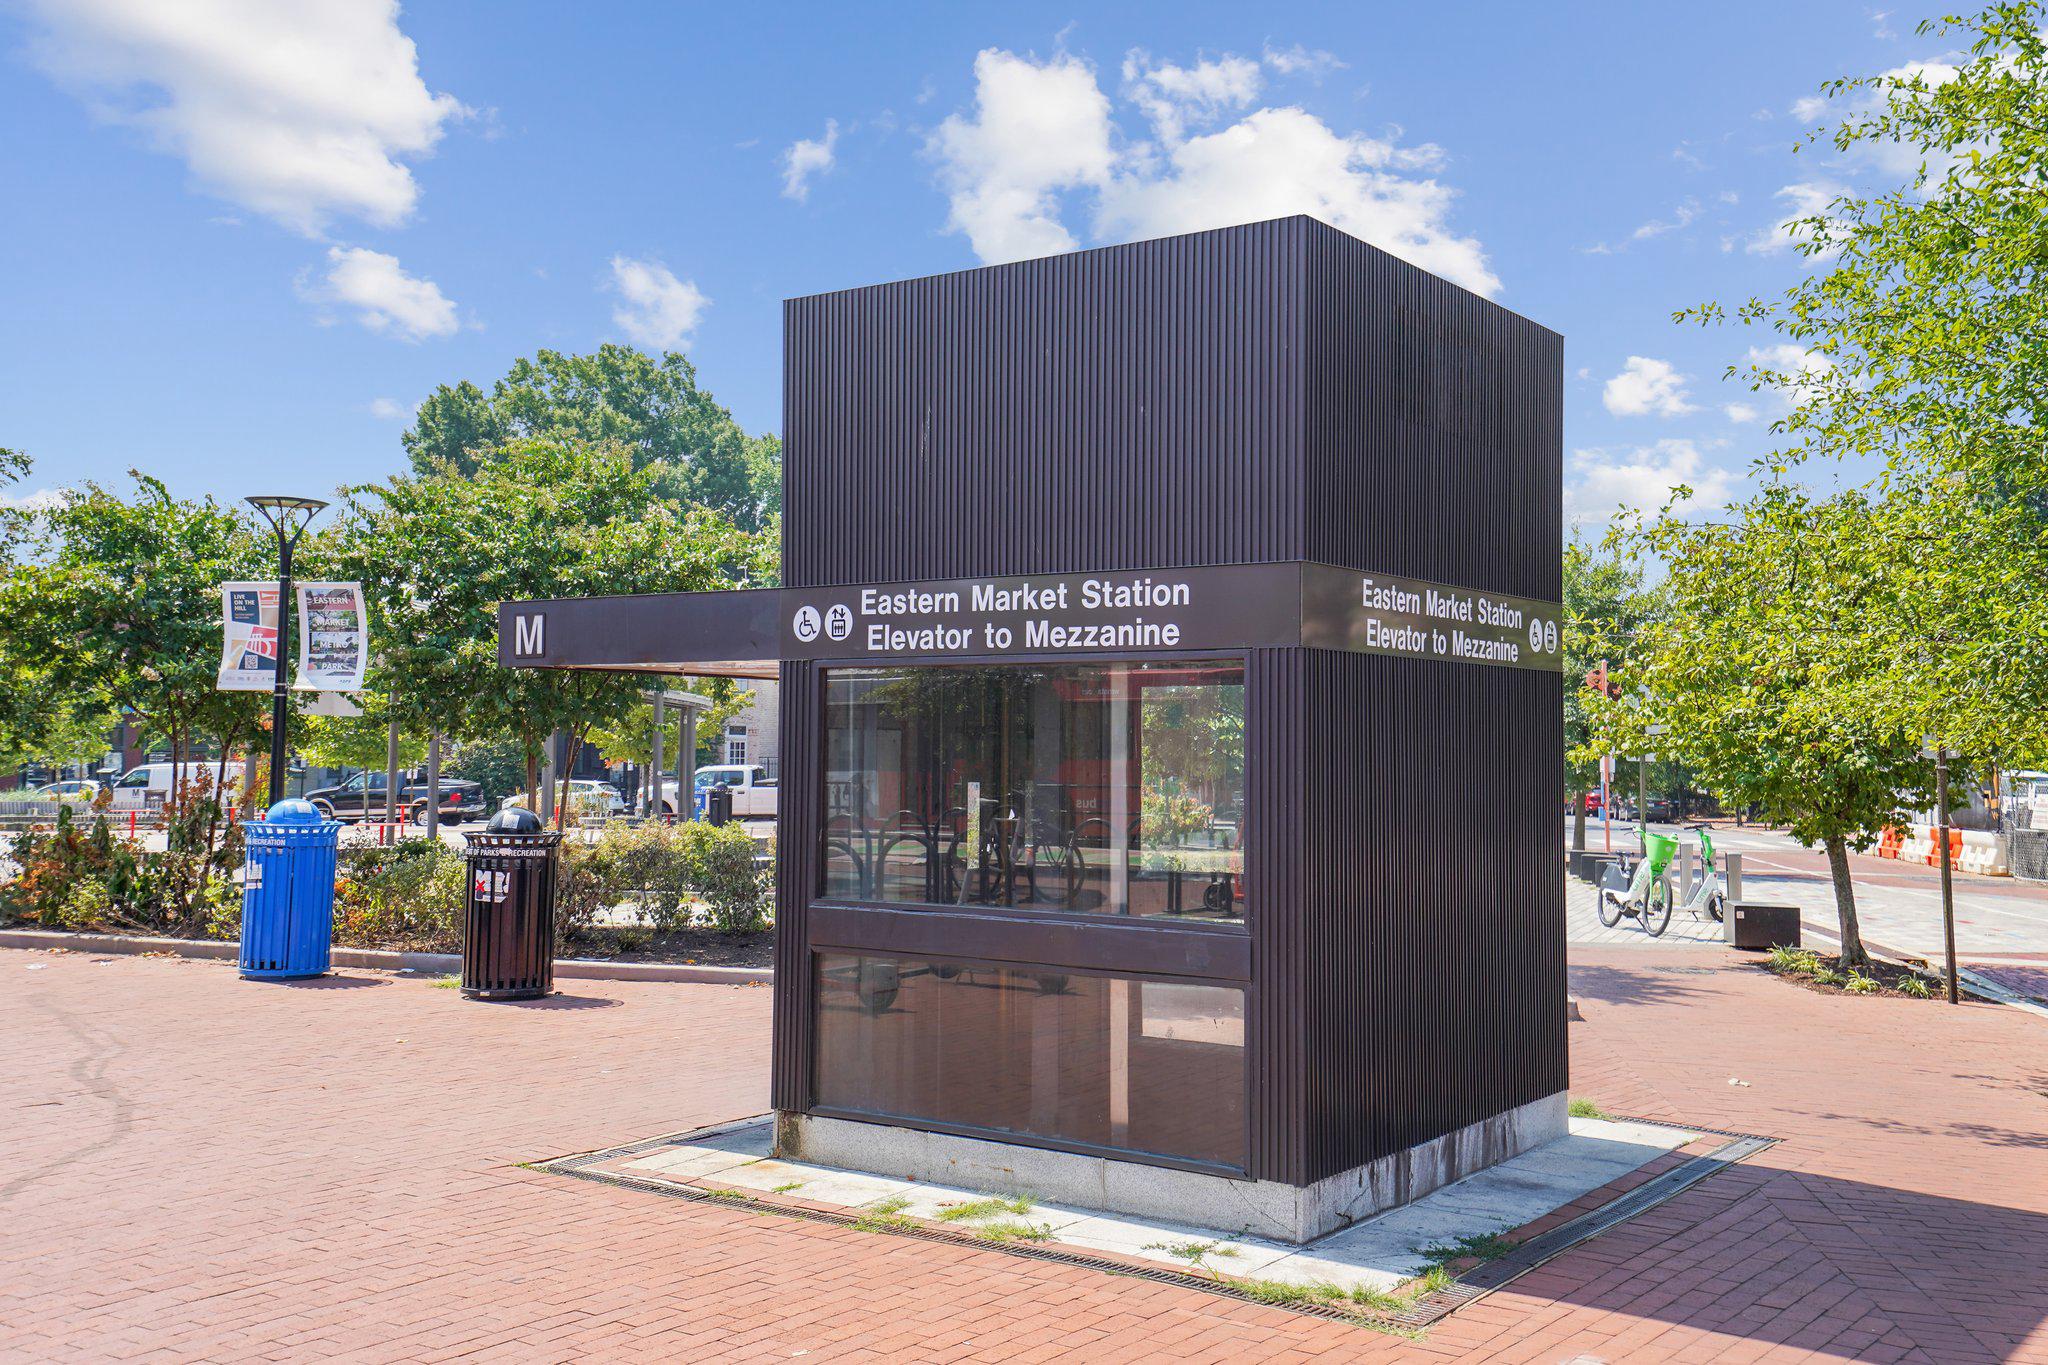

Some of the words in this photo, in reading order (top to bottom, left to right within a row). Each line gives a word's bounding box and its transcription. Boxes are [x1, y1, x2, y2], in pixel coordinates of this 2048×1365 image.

[313, 597, 348, 605] EASTERN
[861, 589, 960, 616] Eastern
[971, 582, 1068, 613] Market
[1081, 578, 1190, 609] Station
[1362, 578, 1420, 615] Eastern
[1425, 589, 1473, 622] Market
[1477, 597, 1522, 630] Station
[515, 614, 543, 655] M
[867, 623, 973, 651] Elevator
[984, 622, 1013, 649] to
[1025, 617, 1180, 648] Mezzanine
[1366, 618, 1427, 653] Elevator
[1432, 628, 1447, 655] to
[1452, 629, 1519, 663] Mezzanine
[320, 641, 348, 649] METRO
[322, 662, 343, 670] PARK
[252, 838, 286, 846] RECREATION
[480, 849, 499, 857] PARKS
[510, 849, 546, 857] RECREATION
